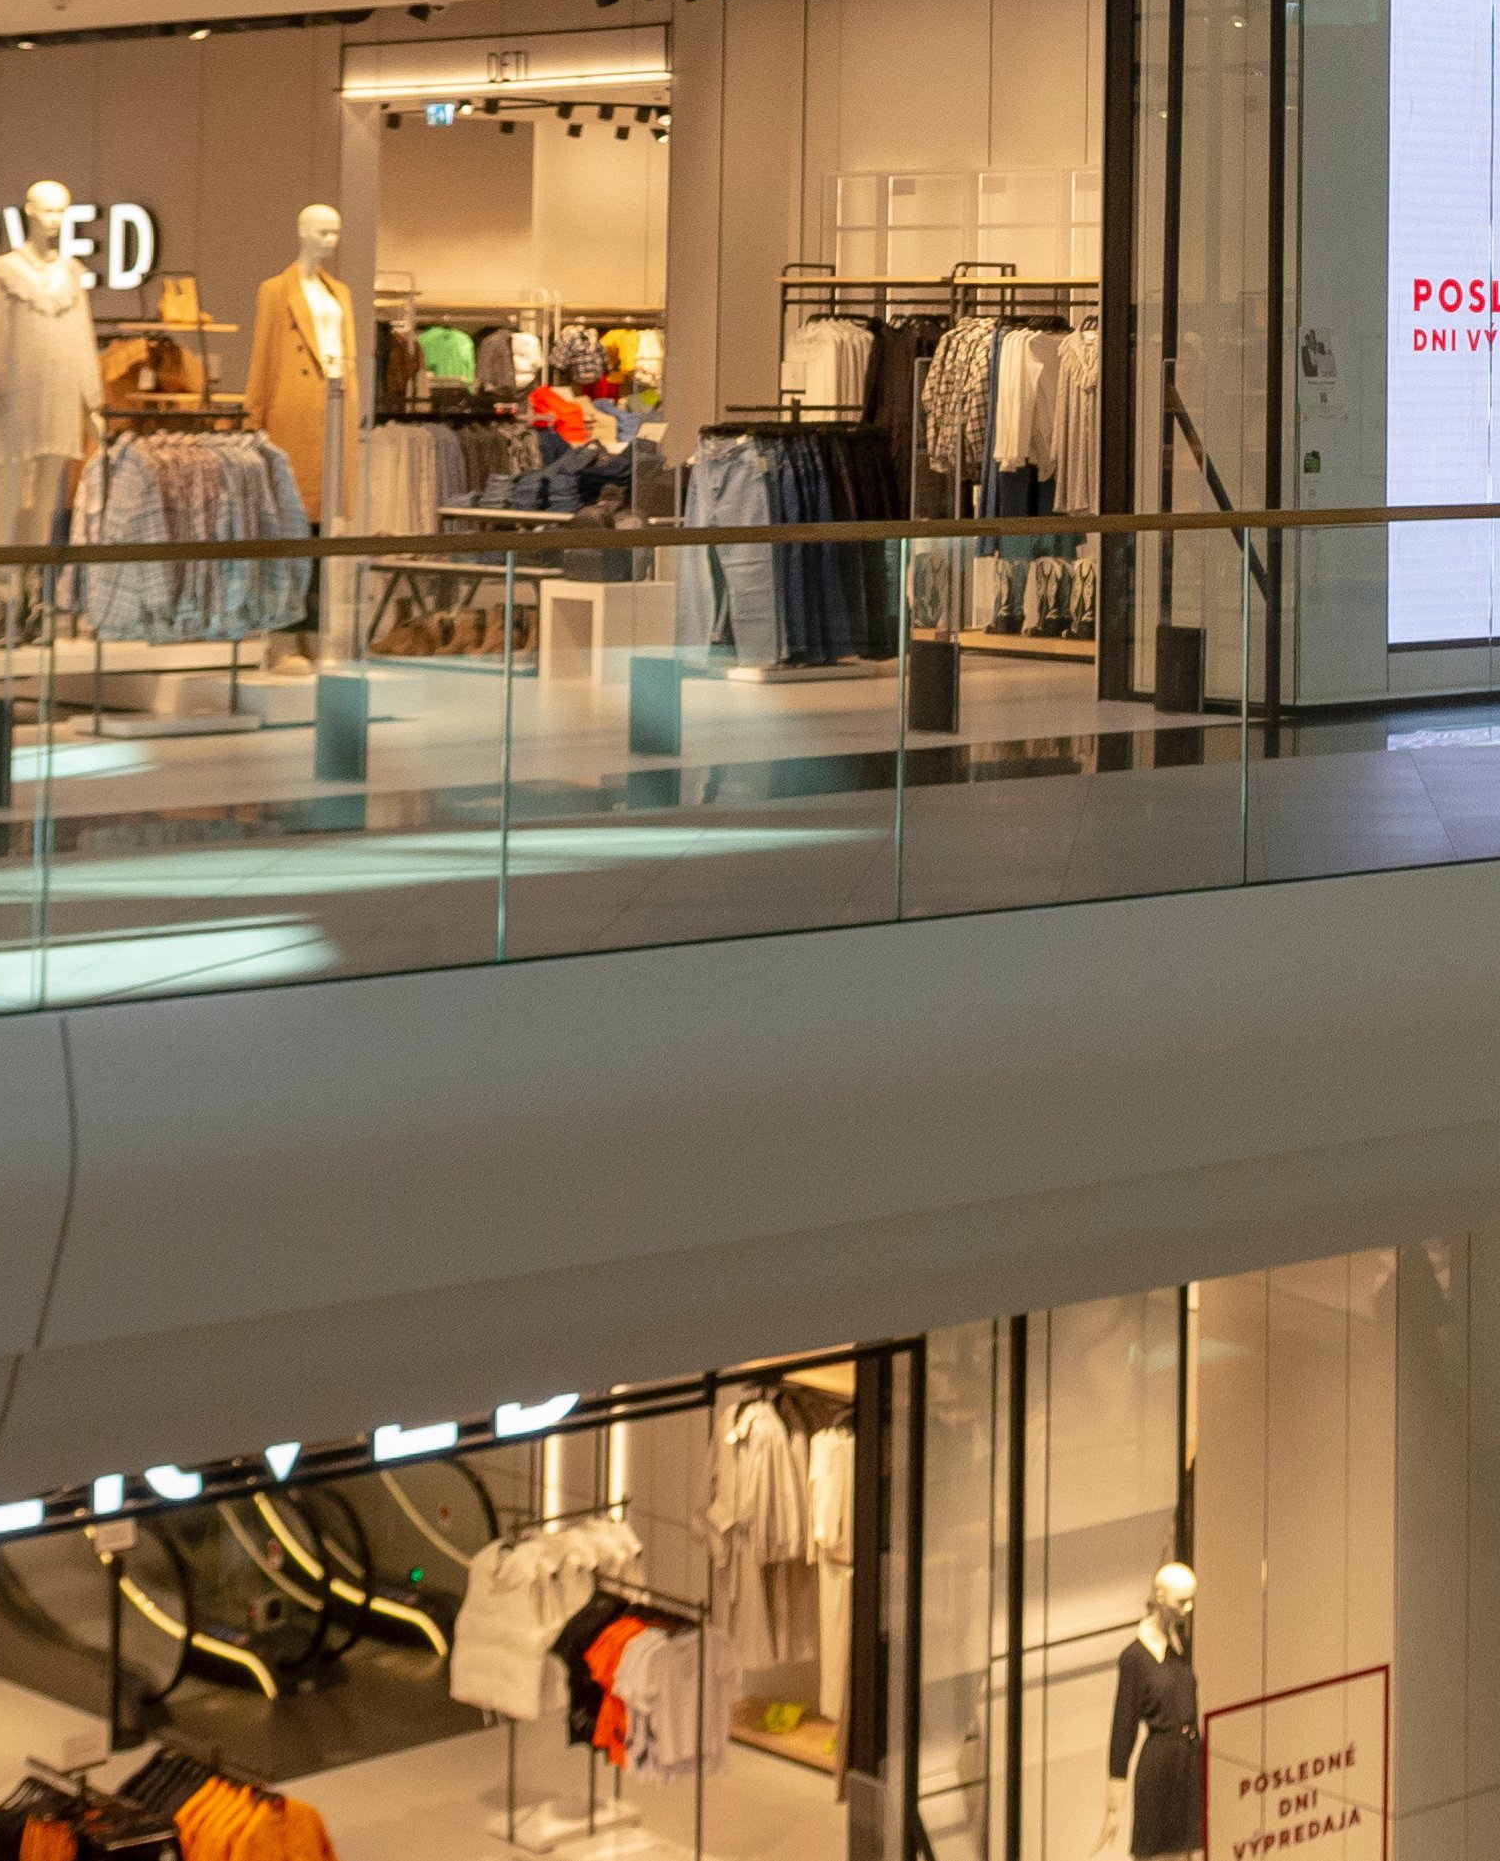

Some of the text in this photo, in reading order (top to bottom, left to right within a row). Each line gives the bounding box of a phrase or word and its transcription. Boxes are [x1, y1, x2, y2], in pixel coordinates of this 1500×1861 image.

[1413, 328, 1456, 352] DNI
[1238, 1742, 1357, 1799] POSLEDNÉ
[1278, 1790, 1319, 1818] DNI
